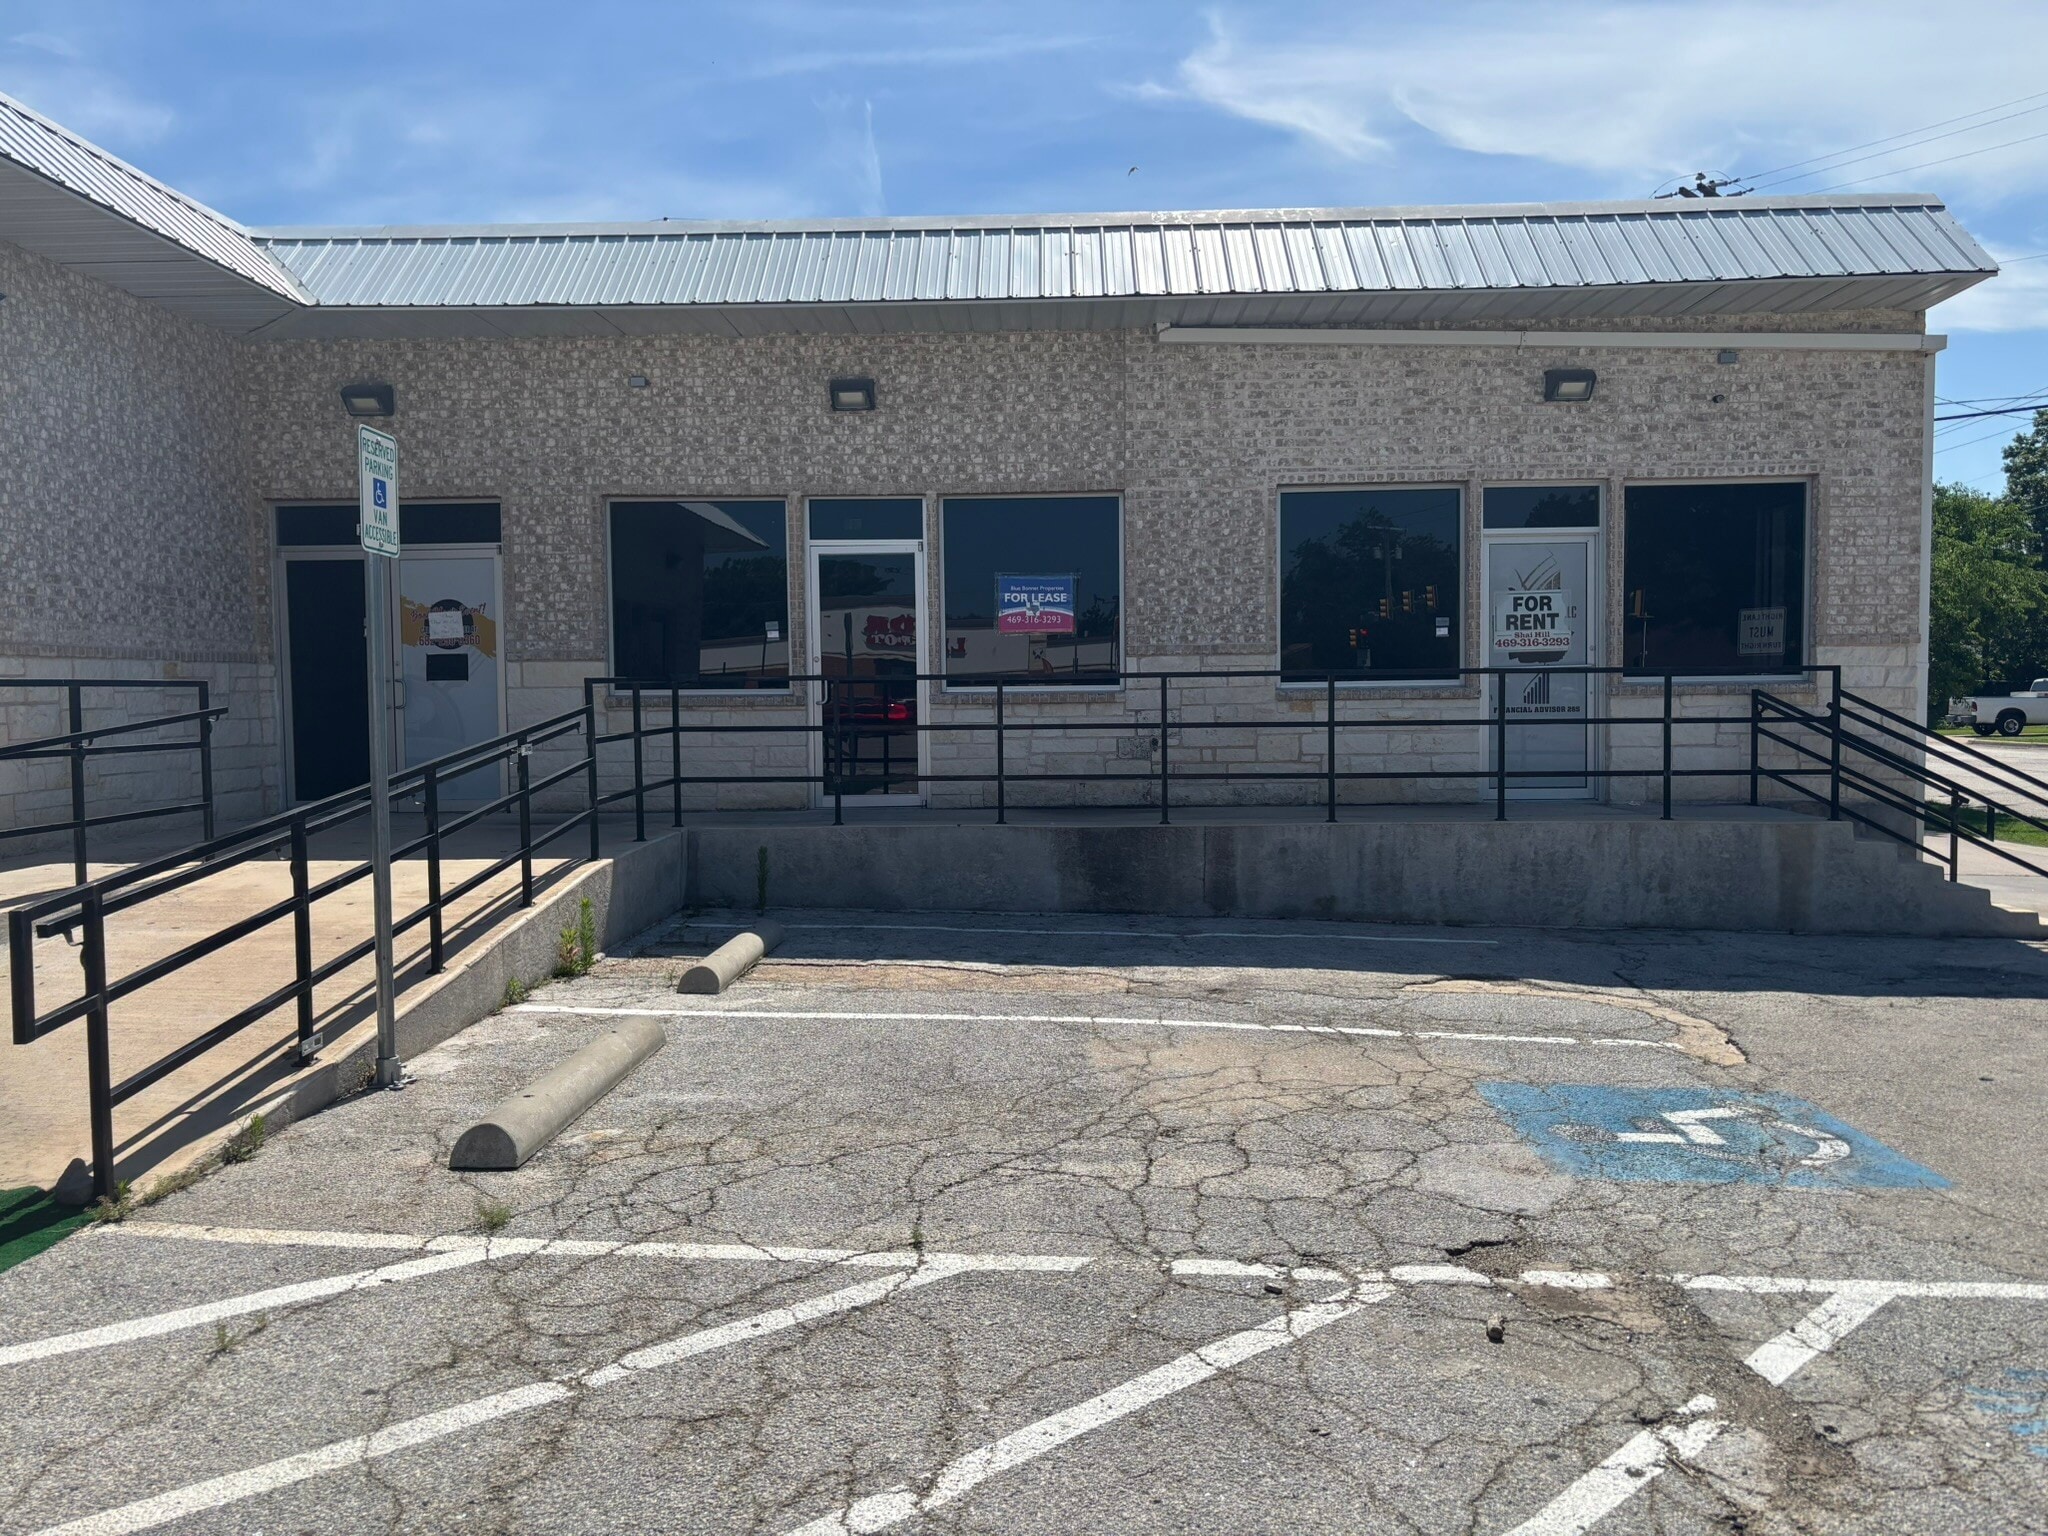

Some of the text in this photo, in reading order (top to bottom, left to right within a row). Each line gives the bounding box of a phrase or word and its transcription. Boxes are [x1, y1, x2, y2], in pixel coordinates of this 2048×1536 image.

[362, 436, 395, 463] RESERVED
[364, 457, 393, 480] PARKING
[373, 508, 388, 527] VAN
[364, 523, 397, 546] ACCESSIBLE
[1004, 593, 1067, 603] FOR LEASE
[1512, 595, 1552, 612] FOR
[1007, 615, 1061, 623] 469-316-3293
[1505, 613, 1559, 631] RENT
[1495, 637, 1570, 648] 469-316-3293
[1514, 631, 1533, 639] Shai
[1493, 706, 1532, 714] FANCIAL
